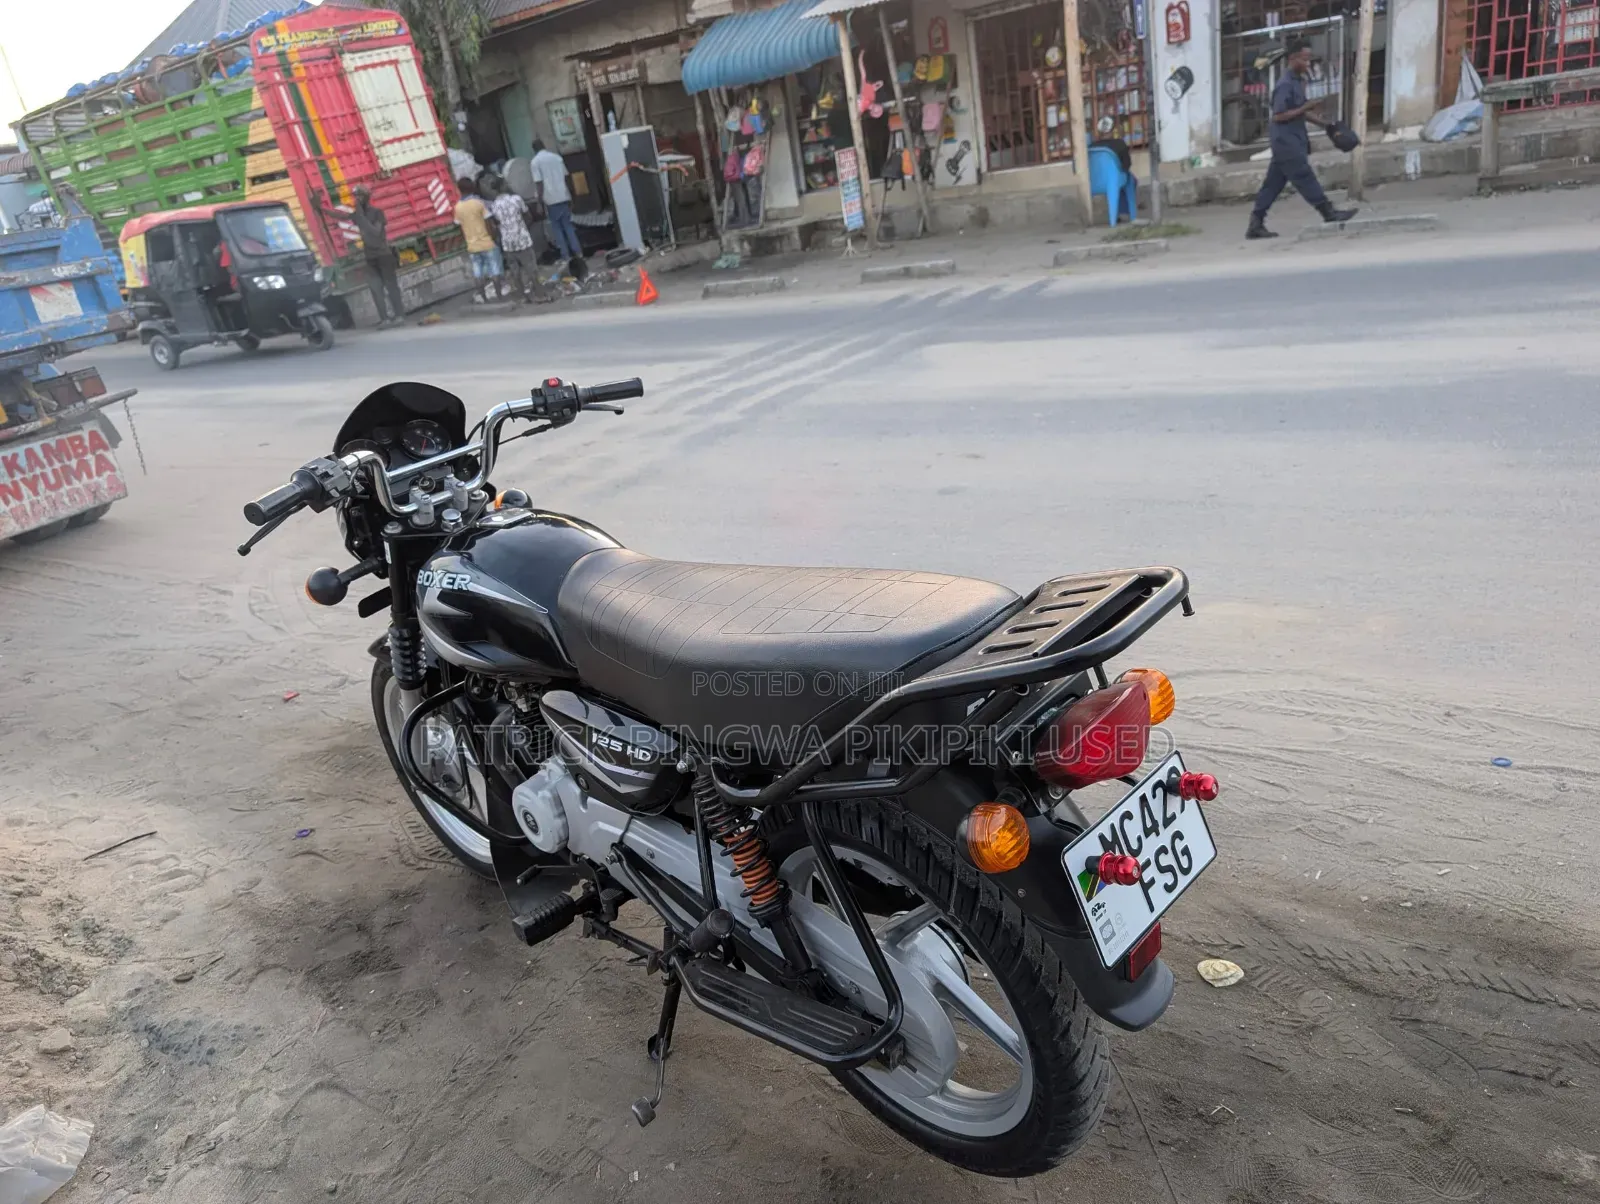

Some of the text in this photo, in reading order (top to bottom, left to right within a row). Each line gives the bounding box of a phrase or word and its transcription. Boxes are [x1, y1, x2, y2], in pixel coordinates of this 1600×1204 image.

[1, 430, 110, 479] KAMBA
[0, 453, 117, 507] NYUMA
[417, 569, 471, 591] BOXER
[592, 732, 652, 762] 125 HD
[1139, 829, 1193, 914] FSG
